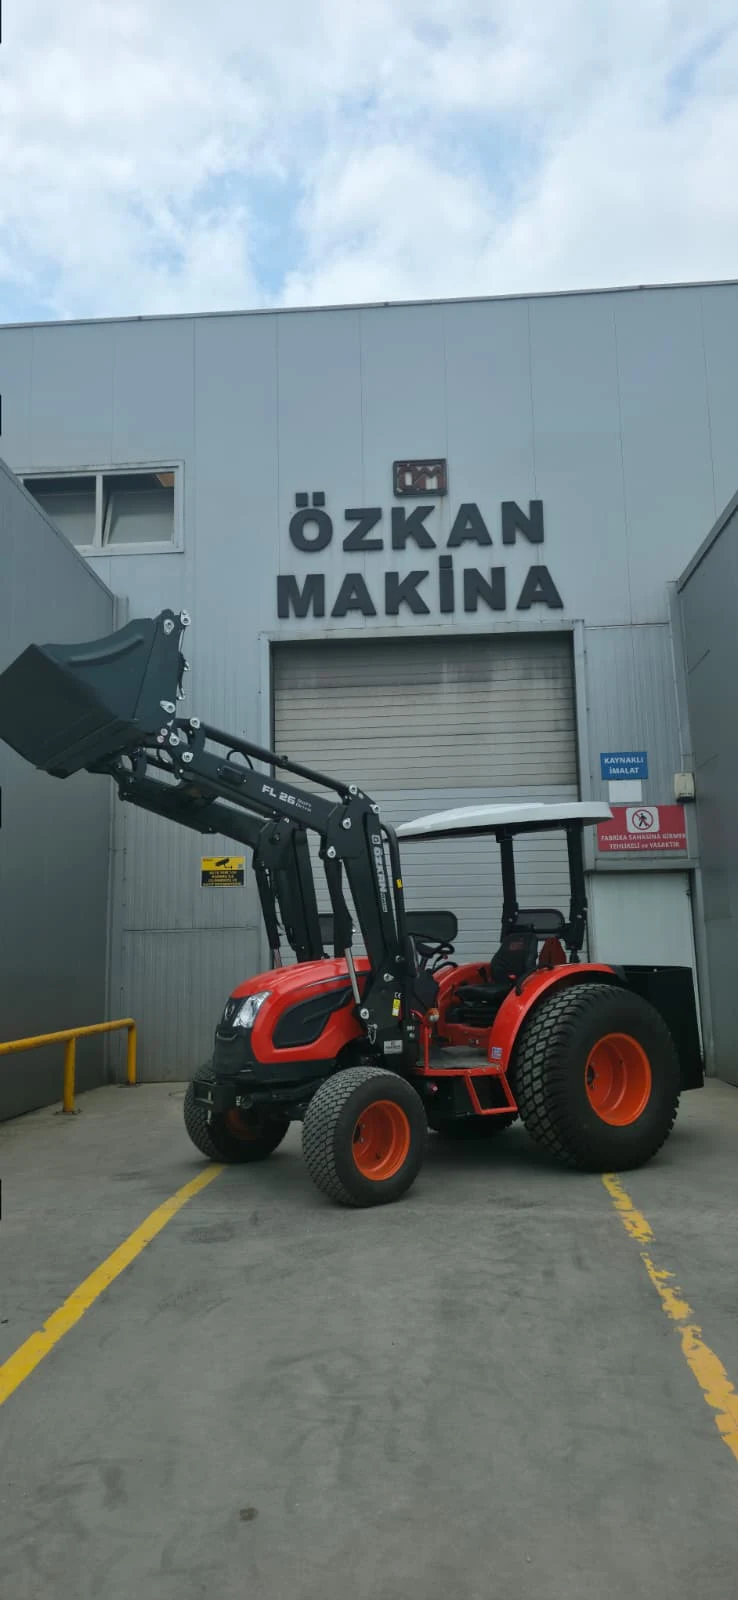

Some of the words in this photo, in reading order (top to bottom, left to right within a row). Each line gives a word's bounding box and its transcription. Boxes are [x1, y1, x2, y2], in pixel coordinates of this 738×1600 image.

[289, 491, 545, 552] ÖZKAN
[276, 555, 564, 619] MAKİNA
[604, 756, 644, 764] KAYNAKLI
[609, 765, 640, 774] İMALAT
[261, 784, 277, 798] FL
[279, 792, 296, 805] 26
